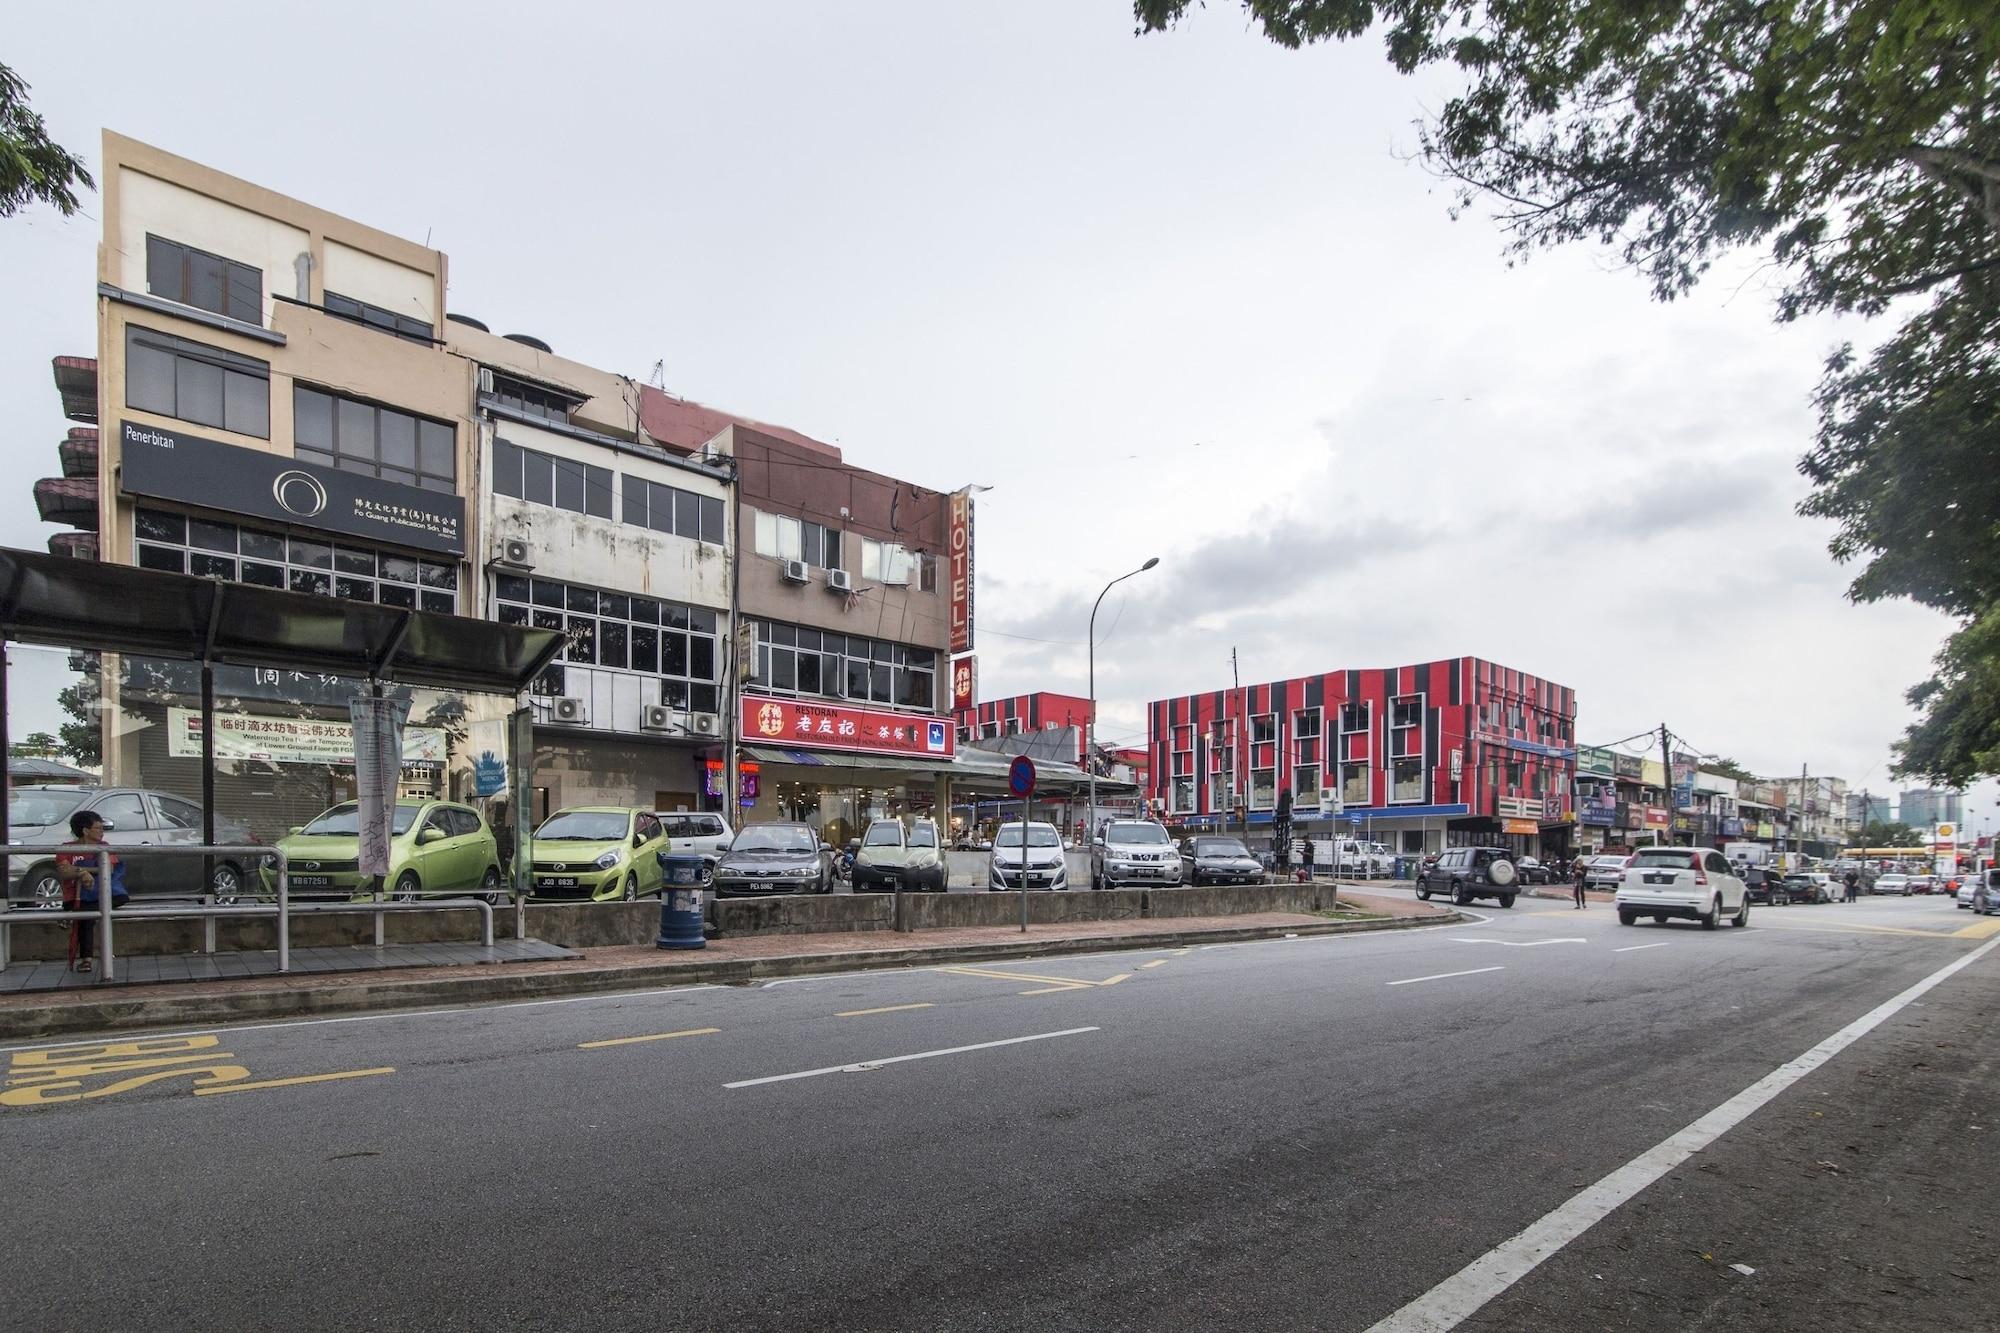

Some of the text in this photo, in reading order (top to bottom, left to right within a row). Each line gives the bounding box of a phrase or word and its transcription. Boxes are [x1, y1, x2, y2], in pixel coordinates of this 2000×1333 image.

[126, 425, 174, 449] Penerbitan
[354, 508, 364, 517] Fo
[366, 510, 389, 523] Guang
[390, 516, 426, 530] Publication
[952, 500, 965, 627] HOTEL
[795, 705, 838, 718] RESTORAN
[242, 733, 280, 742] Waterdrop
[318, 738, 353, 747] Temporary
